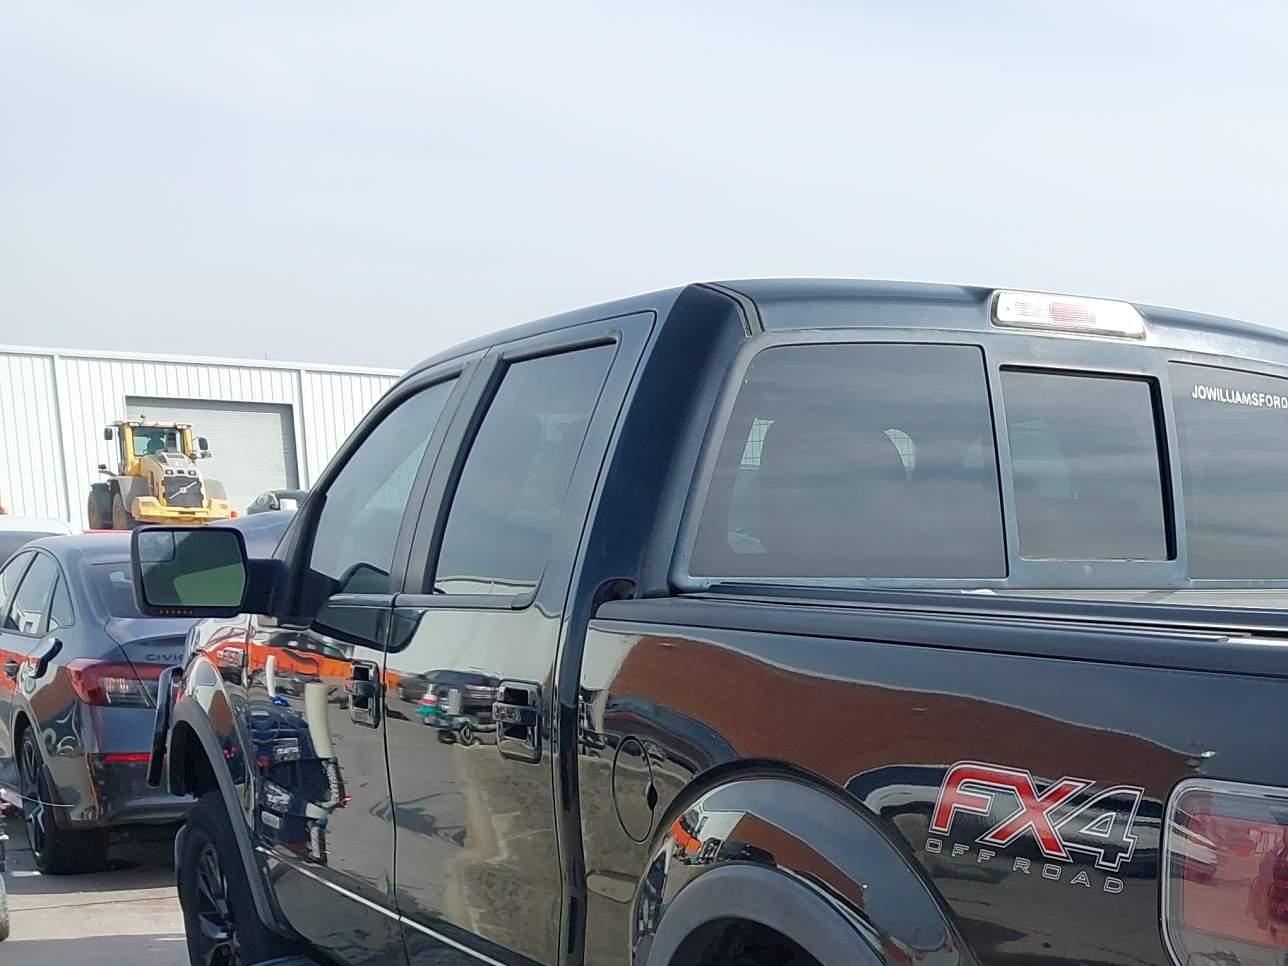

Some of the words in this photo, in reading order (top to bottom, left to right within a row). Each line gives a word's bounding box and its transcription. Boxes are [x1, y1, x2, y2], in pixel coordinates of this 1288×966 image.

[928, 760, 1145, 873] FX4
[924, 837, 996, 863] OFF
[1012, 856, 1124, 894] ROAD
